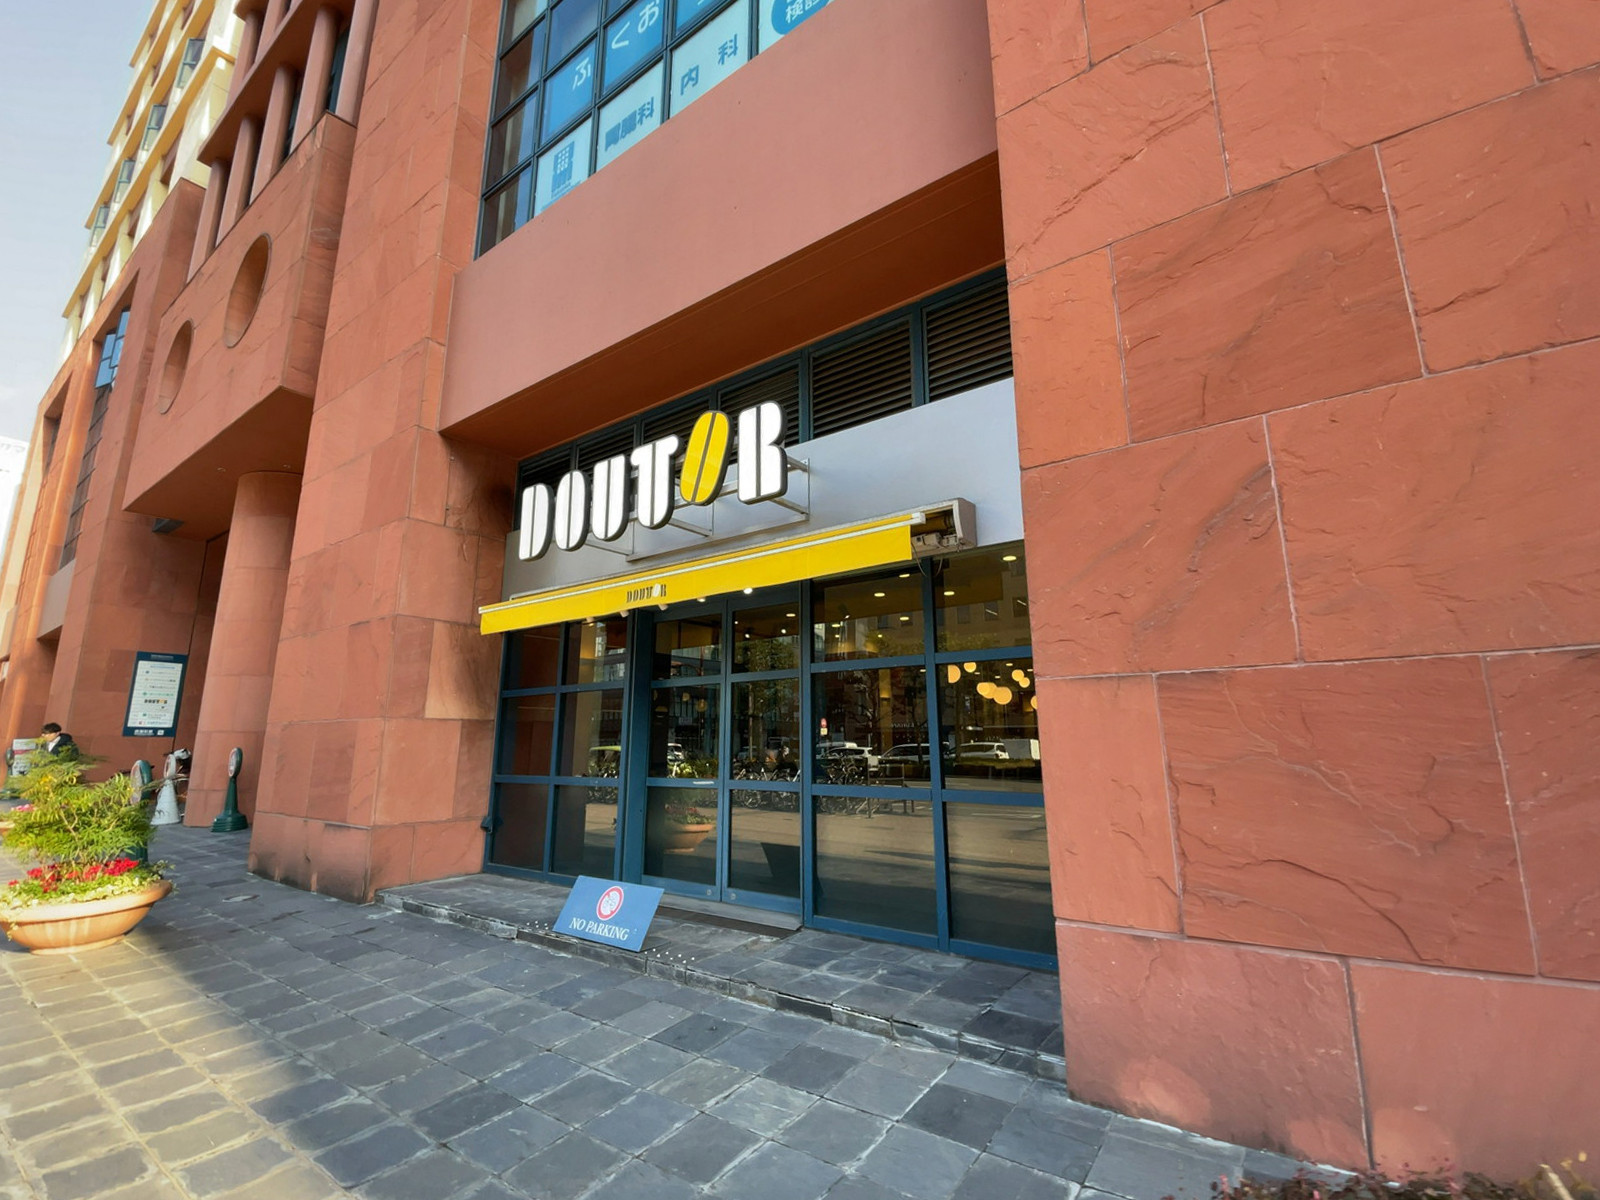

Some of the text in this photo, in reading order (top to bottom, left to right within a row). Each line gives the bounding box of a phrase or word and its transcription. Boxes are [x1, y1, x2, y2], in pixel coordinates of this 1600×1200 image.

[680, 33, 738, 96] 内科
[519, 401, 787, 561] DOUTOR
[569, 918, 629, 941] NO PARKING
